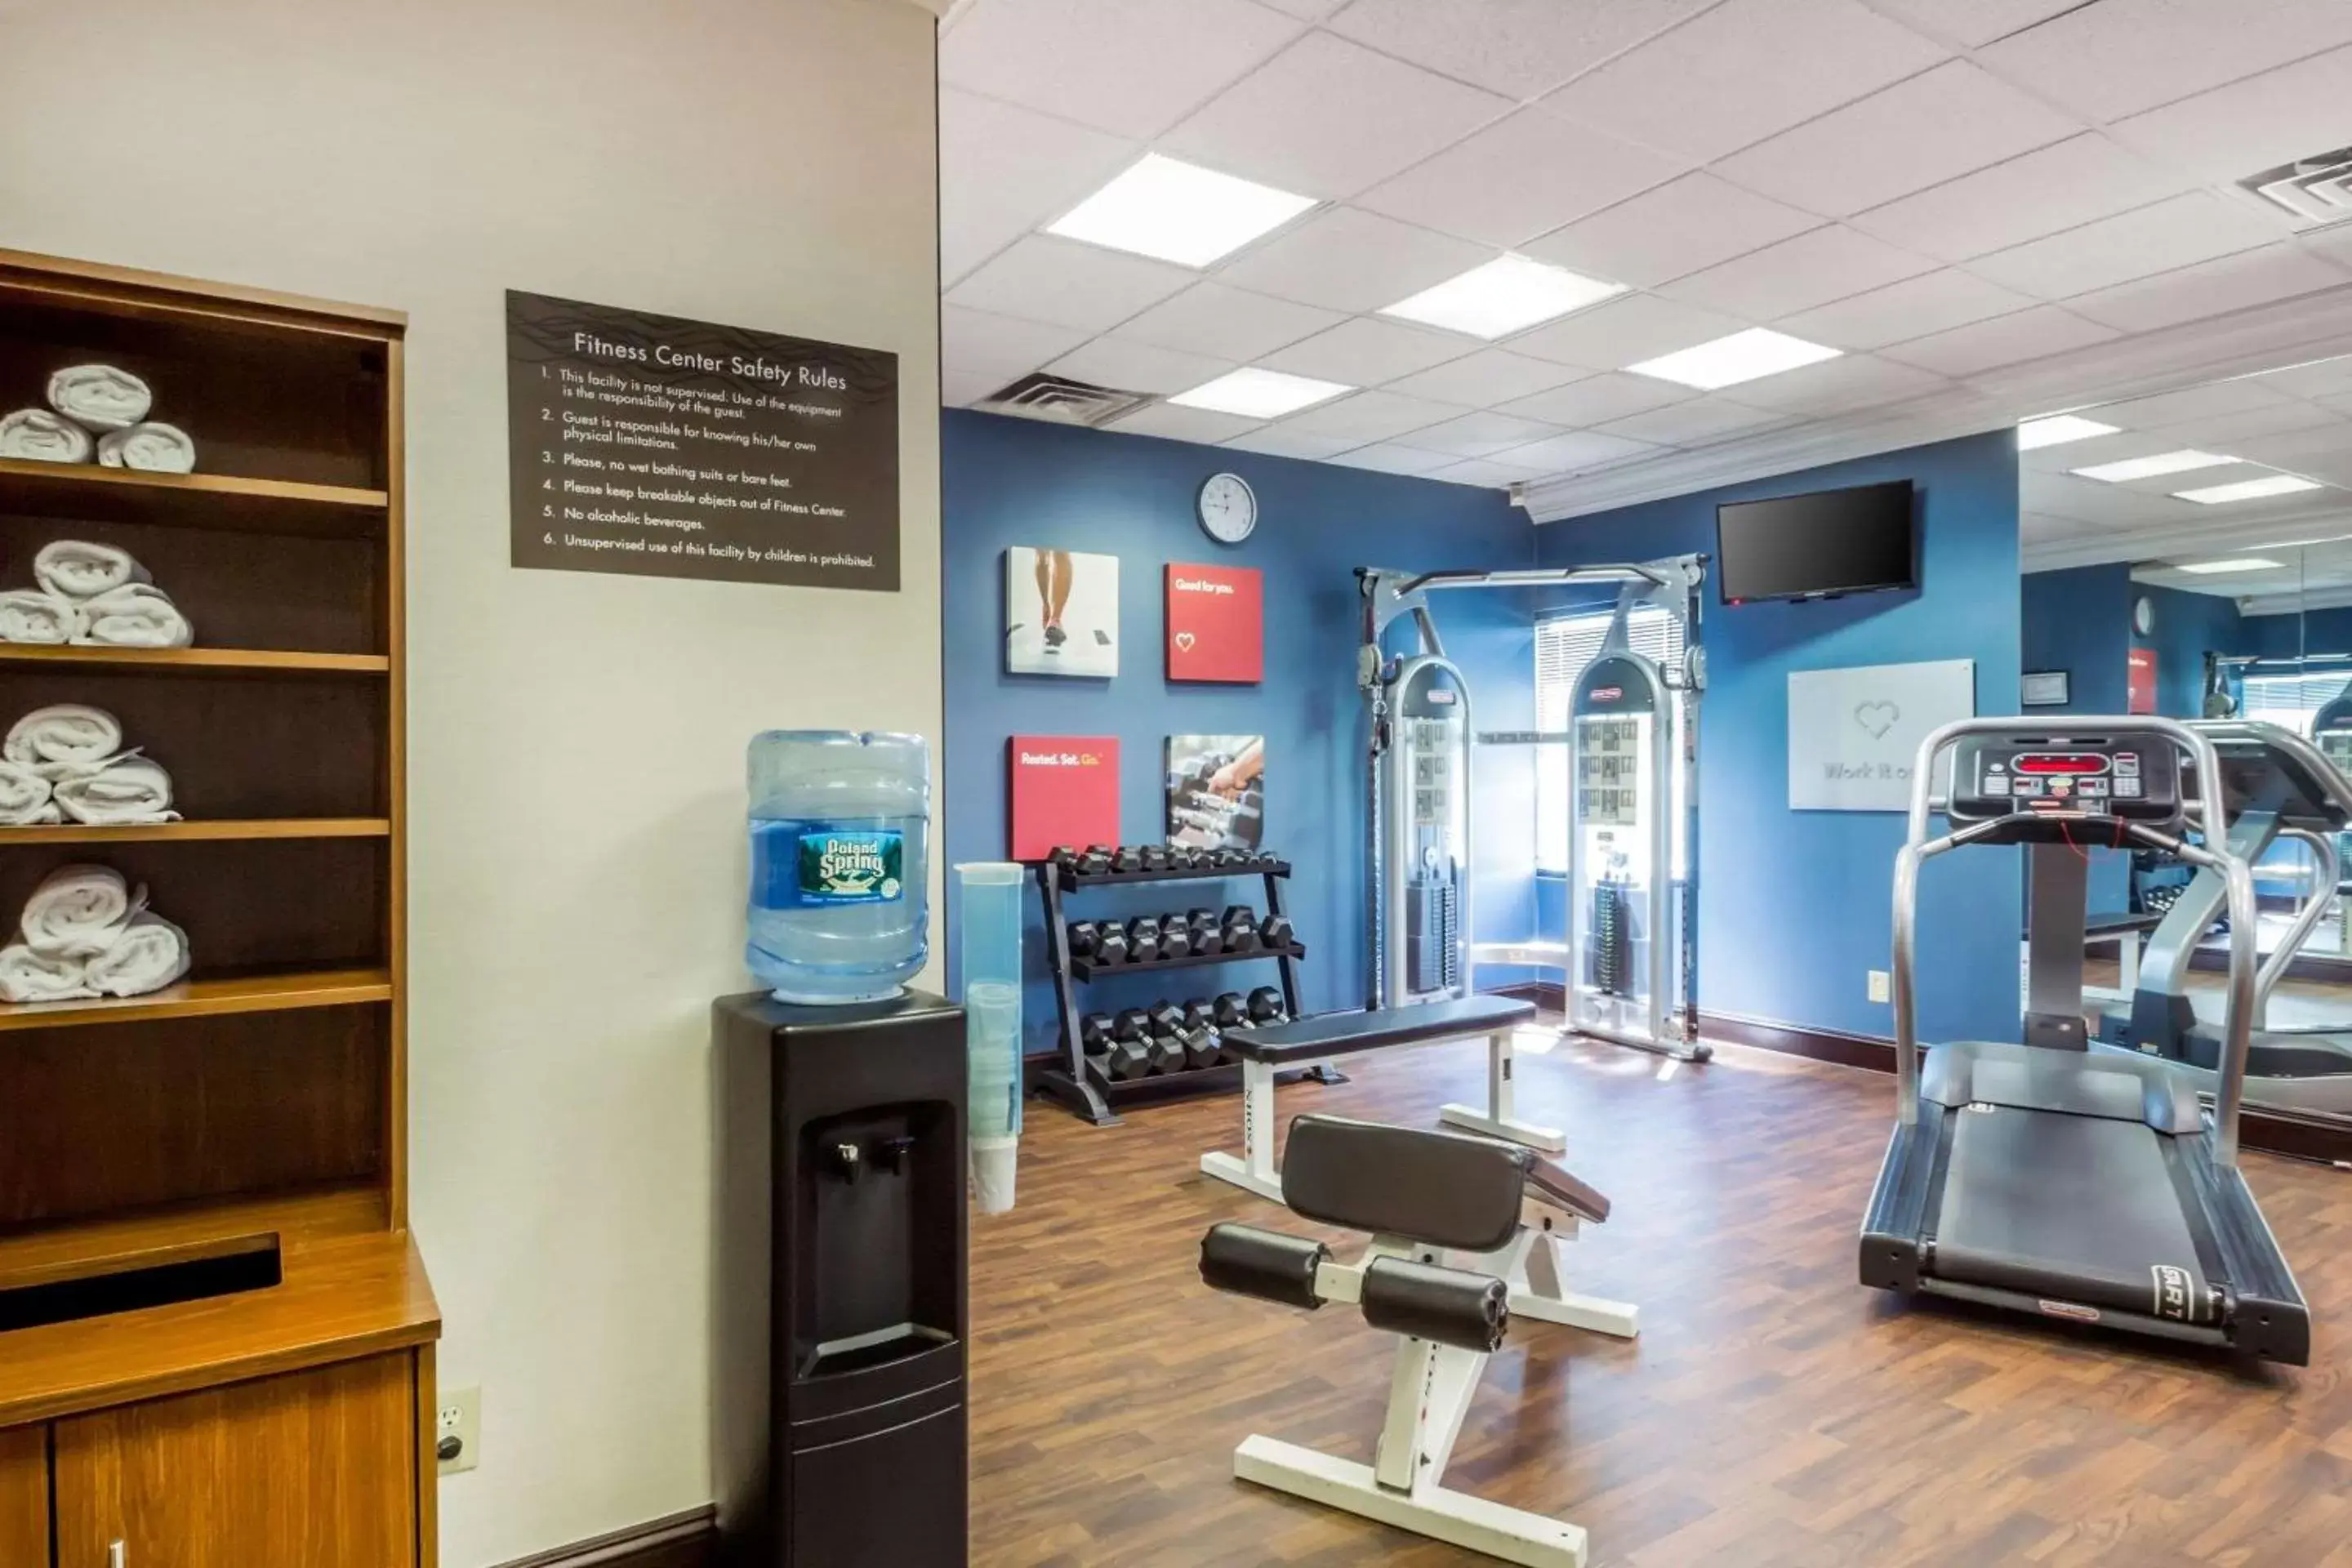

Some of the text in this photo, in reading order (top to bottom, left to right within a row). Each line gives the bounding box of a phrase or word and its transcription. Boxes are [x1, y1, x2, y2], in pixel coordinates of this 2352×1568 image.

[574, 332, 846, 390] Fitness Center Safety Rules
[559, 368, 585, 384] This
[587, 371, 628, 392] facility
[630, 379, 640, 391] is
[644, 383, 663, 394] not
[732, 392, 753, 406] Use
[755, 394, 767, 408] of
[768, 396, 786, 410] the
[787, 403, 842, 417] equipment
[562, 385, 573, 397] is
[576, 385, 595, 399] the
[598, 392, 676, 413] responsibility
[678, 399, 691, 412] of
[693, 401, 711, 415] the
[541, 408, 817, 452] 2. Guest is responsible for knowing his/her own
[563, 425, 613, 443] physical
[542, 450, 555, 464] 3.
[608, 461, 625, 471] no
[627, 463, 650, 473] wet
[652, 461, 697, 481] bathing
[698, 468, 724, 481] suits
[726, 473, 739, 483] or
[741, 470, 768, 486] bare
[542, 478, 555, 490] 4.
[564, 479, 604, 496] Please
[604, 482, 635, 501] keep
[636, 485, 696, 504] breakable
[698, 492, 737, 510] objects
[739, 499, 758, 510] out
[760, 497, 772, 510] of
[773, 499, 809, 514] Fitness
[542, 504, 555, 518] 5.
[564, 507, 585, 520] No
[586, 507, 641, 525] alcoholic
[543, 532, 557, 545] 6.
[564, 533, 645, 551] Unsupervised
[648, 543, 669, 553] use
[670, 540, 684, 554] of
[685, 541, 706, 556] this
[708, 542, 746, 562] facility
[746, 546, 762, 563] by
[764, 547, 807, 563] children
[809, 552, 818, 564] is
[1176, 578, 1201, 591] Good
[1022, 751, 1059, 764] Rested.
[1823, 761, 1873, 780] Work
[827, 839, 878, 855] Poland
[819, 853, 885, 879] Spring
